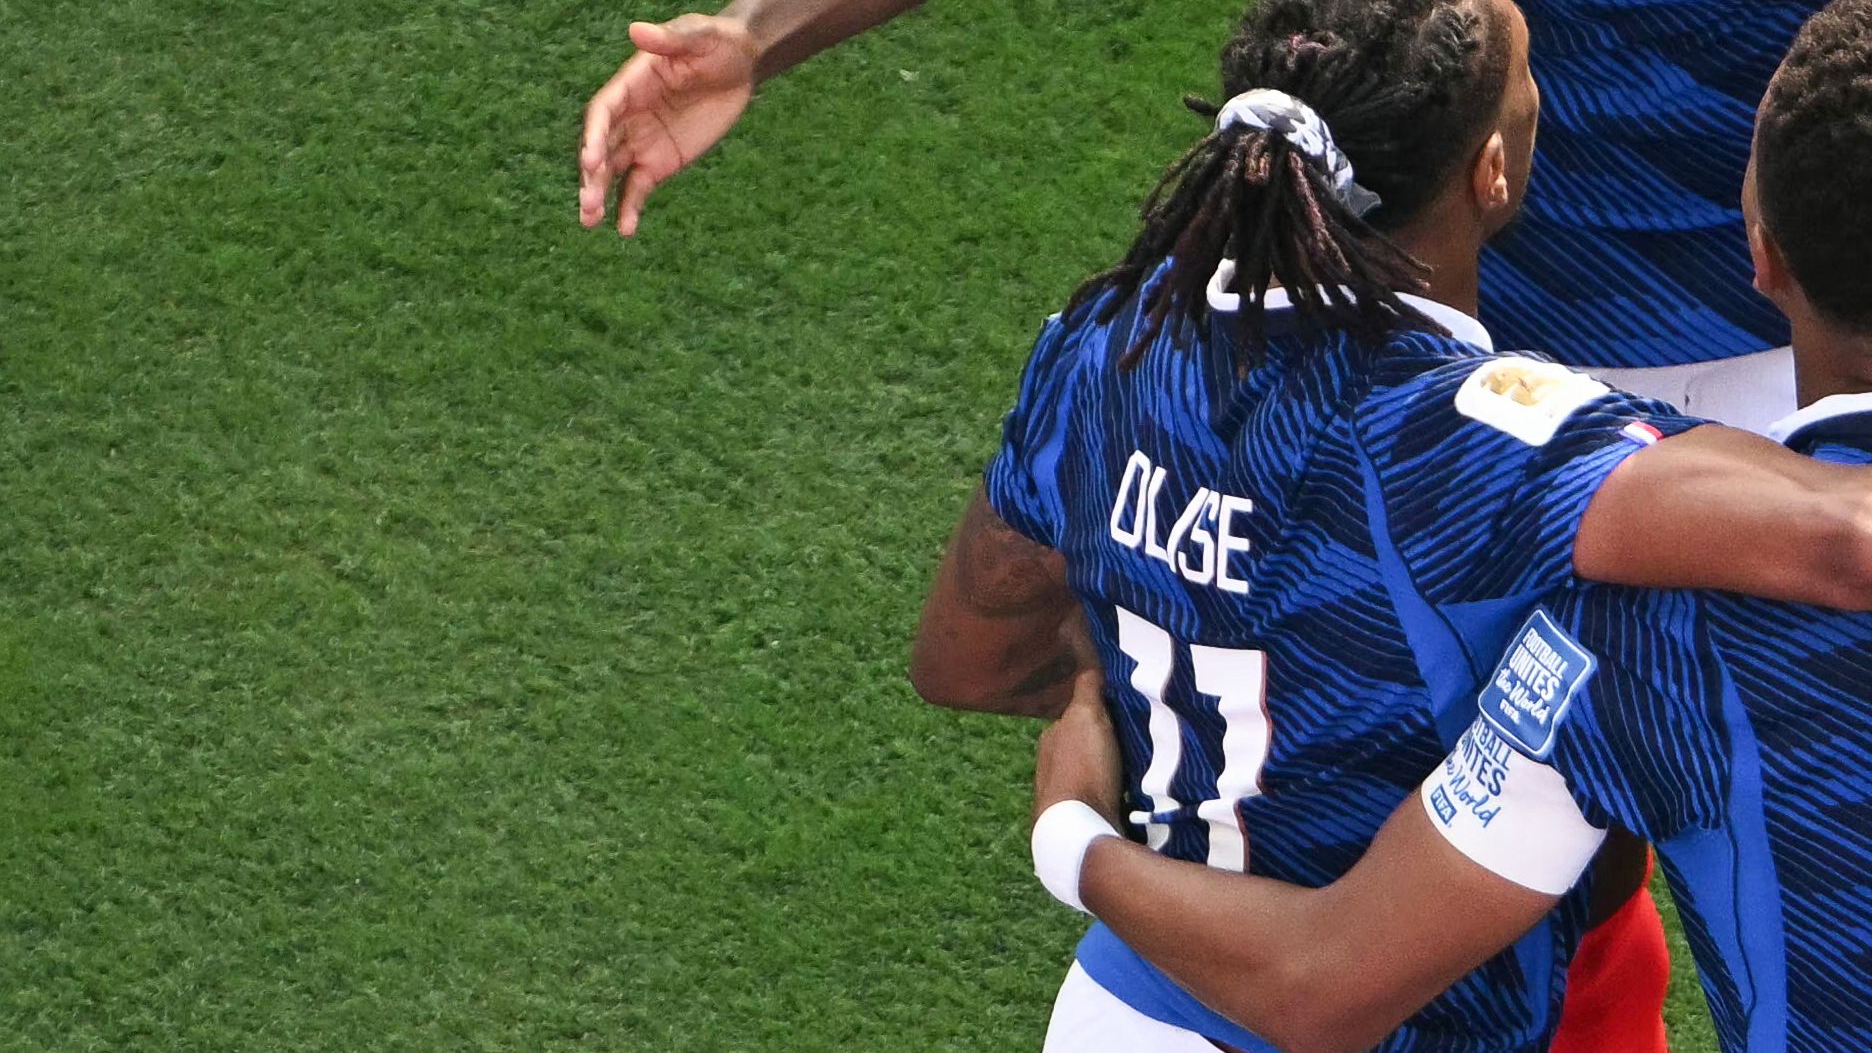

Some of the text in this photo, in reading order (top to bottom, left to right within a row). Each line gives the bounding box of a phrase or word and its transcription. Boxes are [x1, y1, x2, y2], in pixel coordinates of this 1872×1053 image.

[1109, 449, 1253, 595] OLISE
[1509, 644, 1560, 702] UNITES
[1522, 627, 1568, 679] FOOTBALL
[1500, 699, 1520, 724] FIFA
[1509, 680, 1551, 725] World
[1114, 604, 1272, 874] 11
[1449, 765, 1501, 828] World
